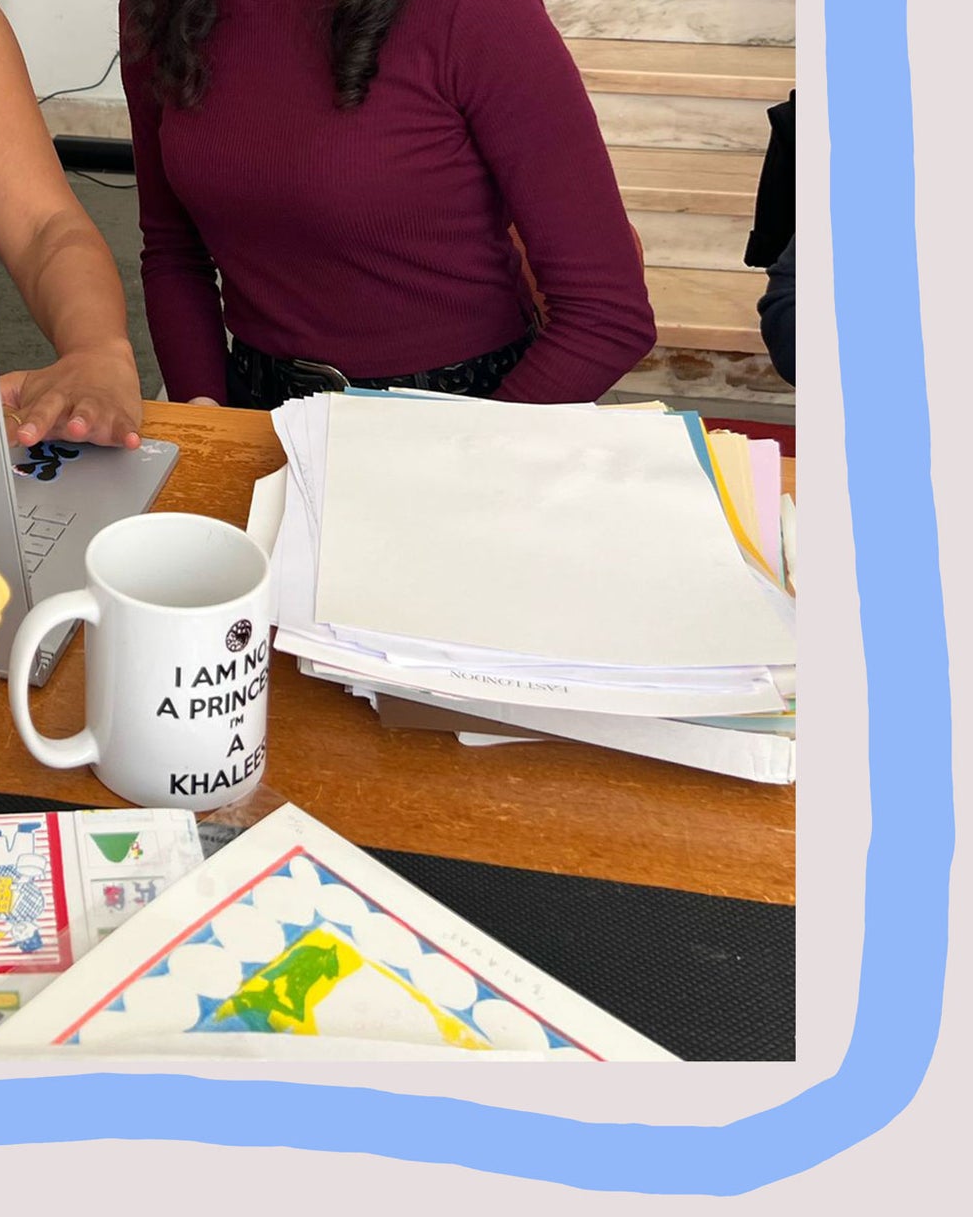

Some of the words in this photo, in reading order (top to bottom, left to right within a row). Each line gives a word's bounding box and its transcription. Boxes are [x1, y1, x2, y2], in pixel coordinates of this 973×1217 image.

[191, 659, 237, 688] AM
[450, 670, 522, 688] LONDON
[156, 697, 180, 719] A
[229, 714, 244, 729] I'M
[226, 733, 245, 758] A
